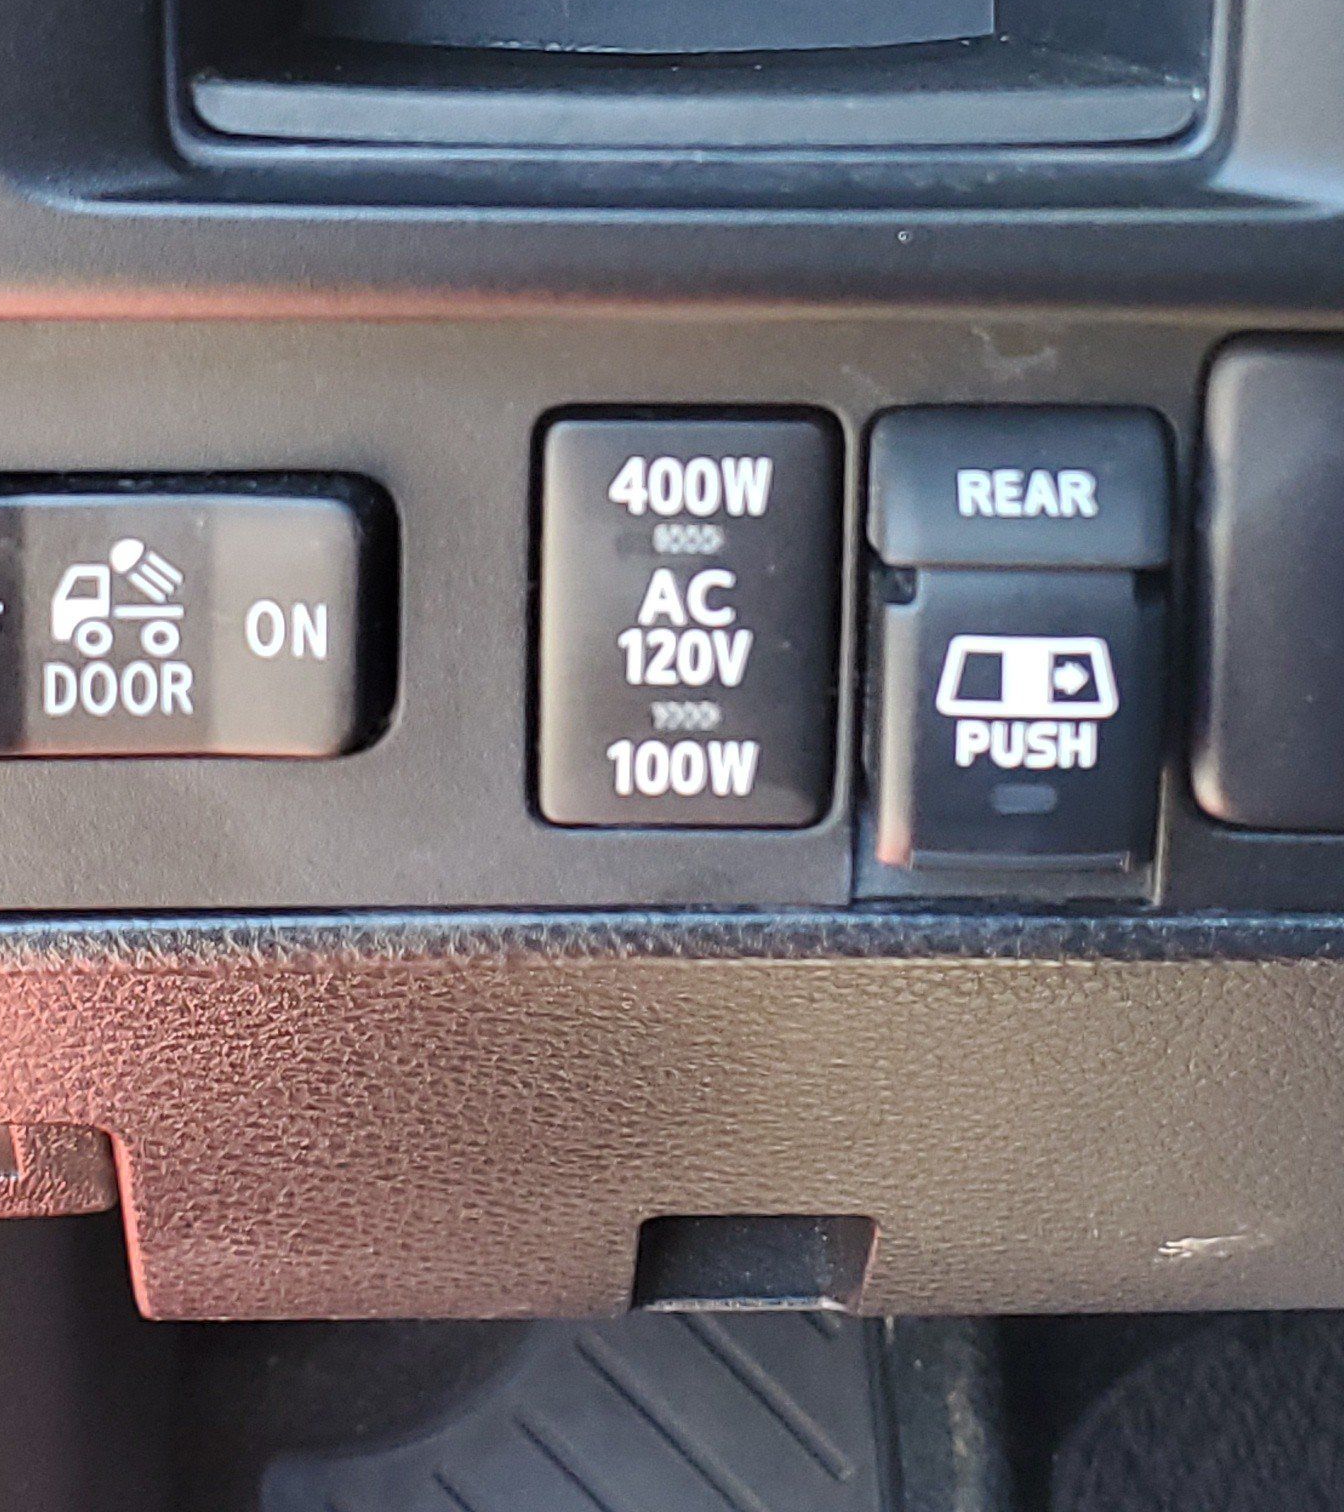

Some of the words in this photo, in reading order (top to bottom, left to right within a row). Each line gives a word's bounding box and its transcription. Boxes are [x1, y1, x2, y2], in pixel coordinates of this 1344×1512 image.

[608, 456, 773, 517] 400W
[957, 468, 1100, 518] REAR
[637, 568, 737, 627] AC
[244, 599, 328, 660] ON
[617, 627, 753, 687] 120V
[43, 660, 195, 716] DOOR
[606, 739, 760, 797] 100W
[955, 720, 1098, 769] PUSH
